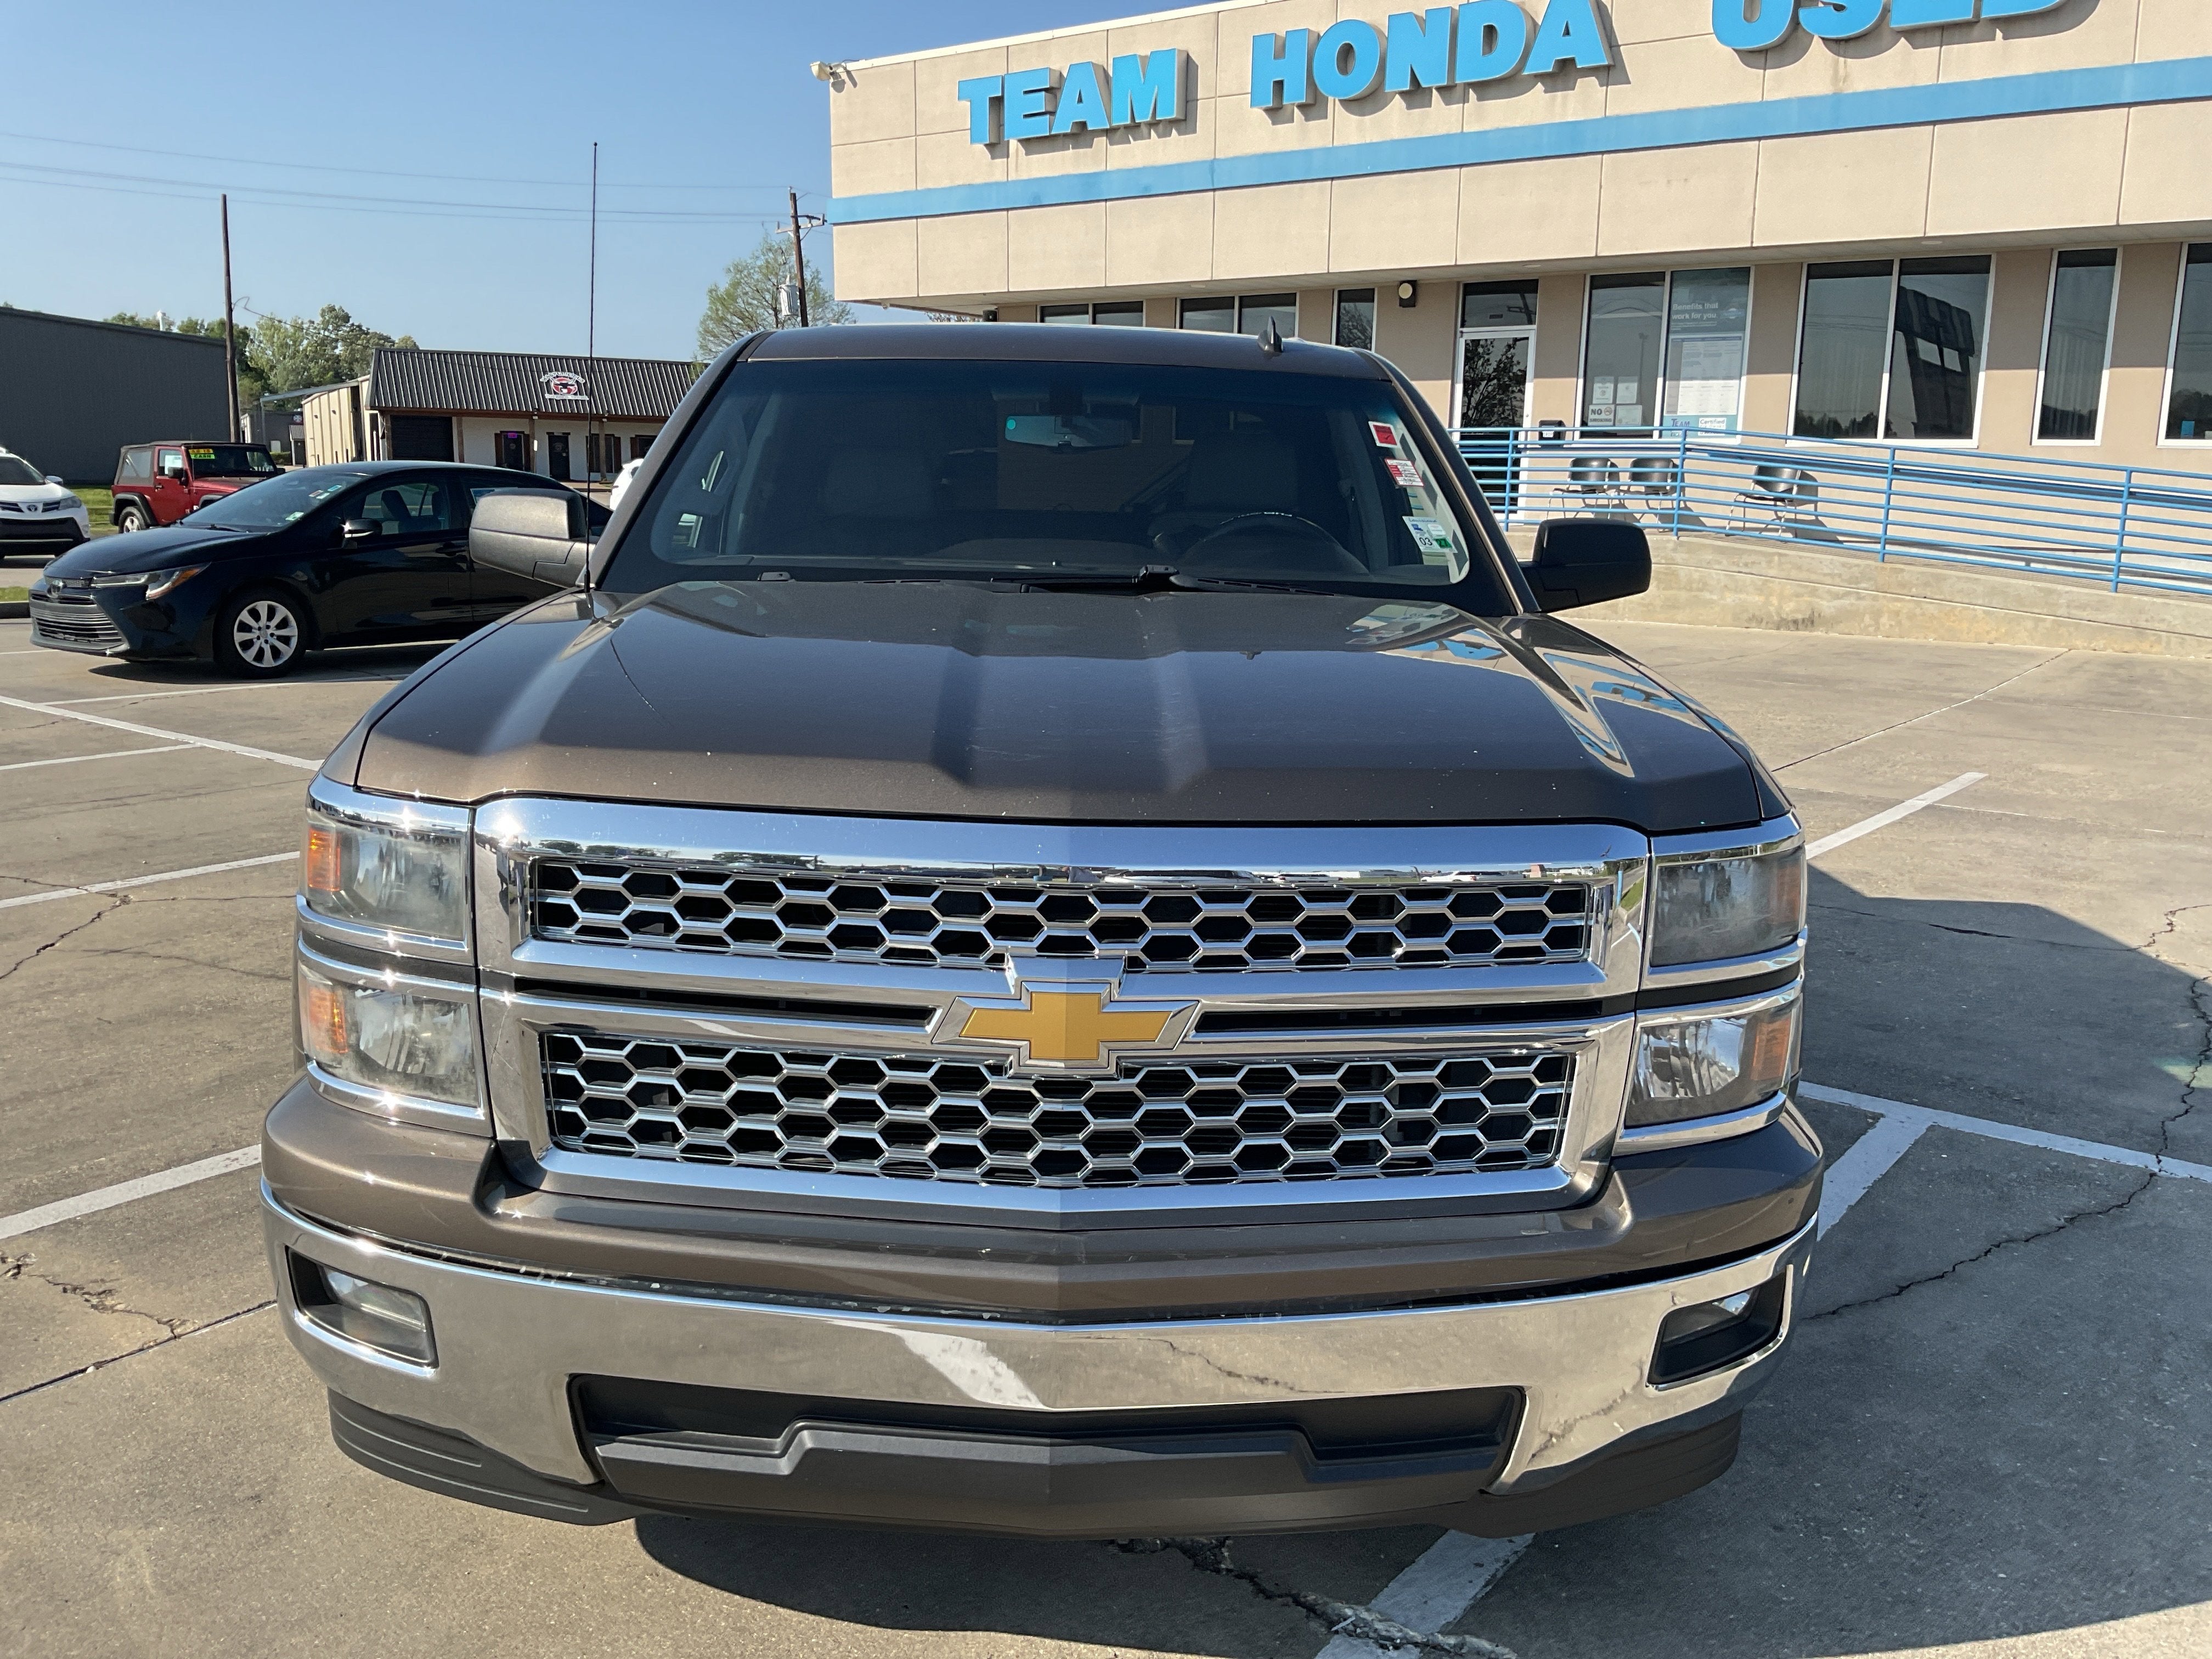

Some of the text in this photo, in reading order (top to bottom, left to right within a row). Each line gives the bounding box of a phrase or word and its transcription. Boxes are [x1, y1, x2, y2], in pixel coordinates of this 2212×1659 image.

[958, 48, 1178, 145] TEAM
[1250, 0, 1607, 109] HONDA
[1671, 419, 1690, 427] TEAM
